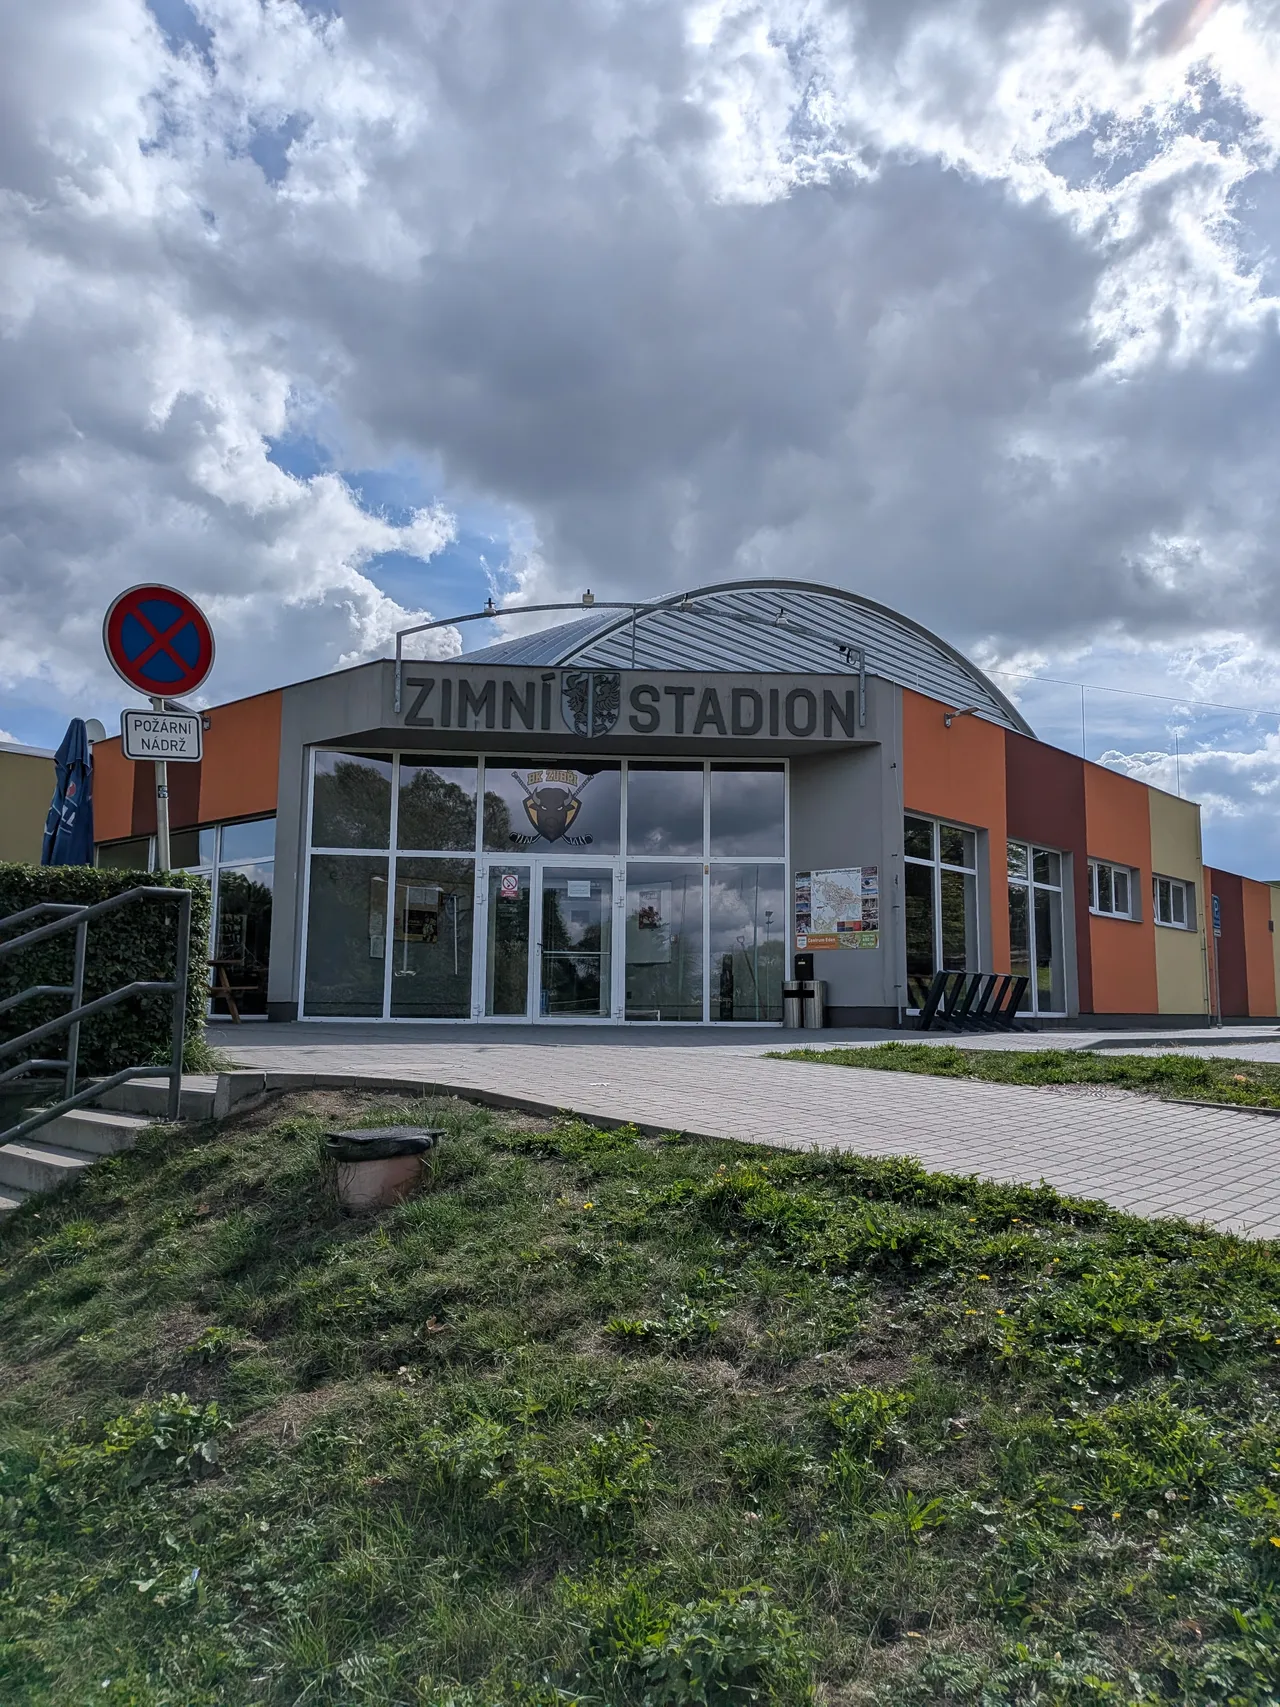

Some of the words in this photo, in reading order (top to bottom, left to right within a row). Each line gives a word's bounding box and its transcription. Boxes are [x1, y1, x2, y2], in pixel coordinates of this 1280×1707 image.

[404, 672, 555, 730] ZIMNÍ
[629, 684, 855, 737] STADION
[134, 718, 191, 734] POŽÁRNÍ
[141, 736, 186, 752] NÁDRŽ
